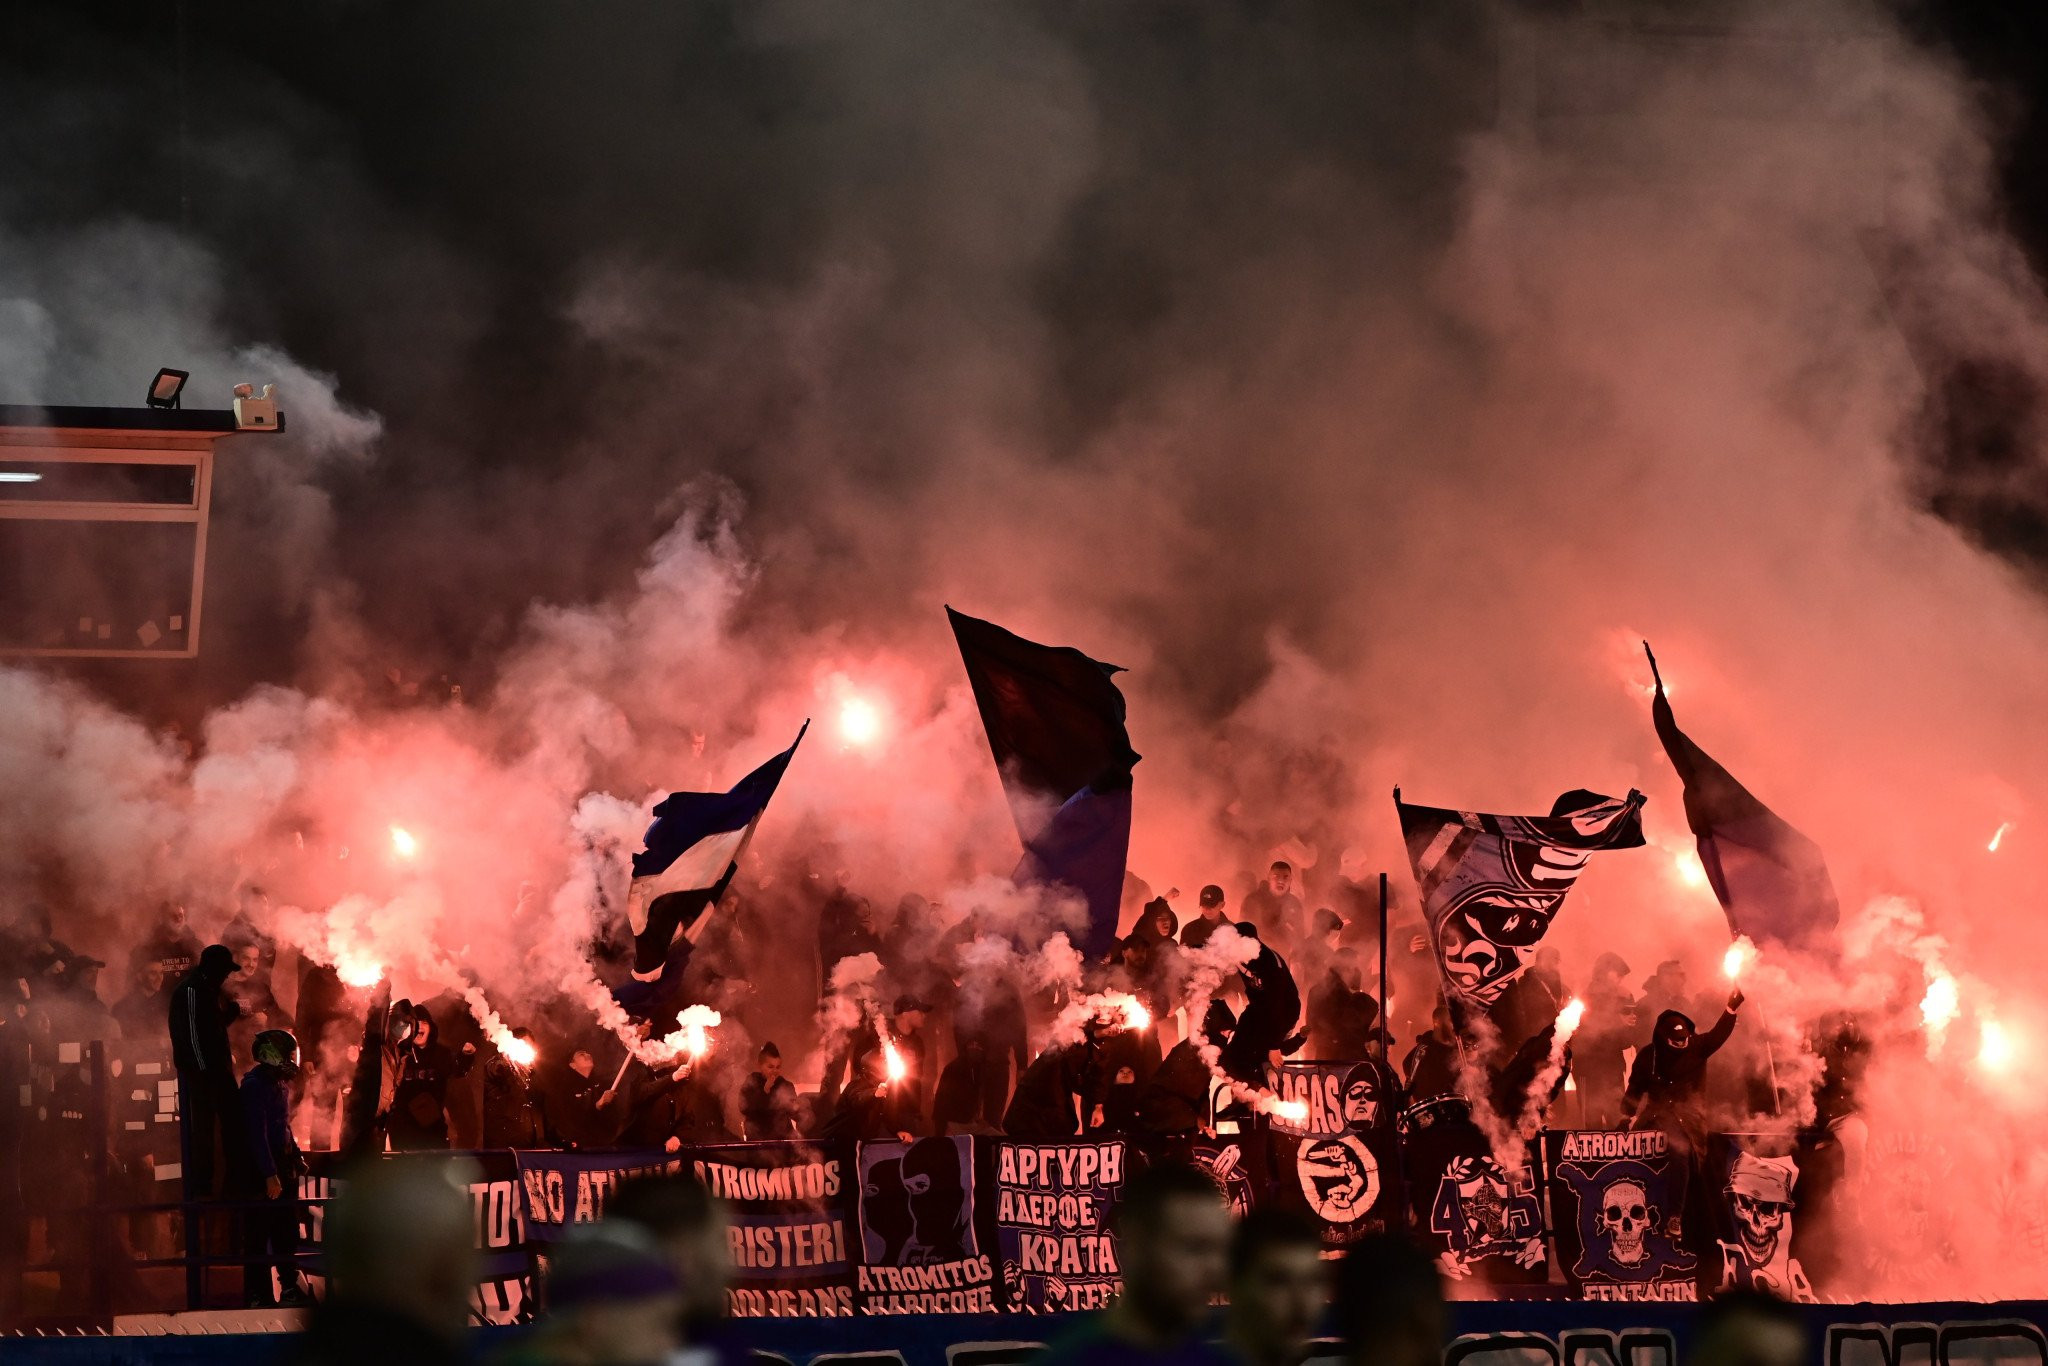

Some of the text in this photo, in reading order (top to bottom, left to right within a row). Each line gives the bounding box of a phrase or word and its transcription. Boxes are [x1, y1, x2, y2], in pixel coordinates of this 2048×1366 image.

[999, 1144, 1122, 1187] ΑΡΓΥΡΗ
[1563, 1132, 1669, 1160] ATROMITO
[523, 1168, 565, 1224] NO
[999, 1190, 1096, 1229] ΑΔΕΡΦΕ
[726, 1220, 846, 1268] RISTERI
[1020, 1233, 1119, 1274] ΚΡΑΤΑ
[858, 1254, 993, 1292] ATROMITOS
[724, 1285, 854, 1318] OLIGANS
[867, 1286, 993, 1316] HARDCORE
